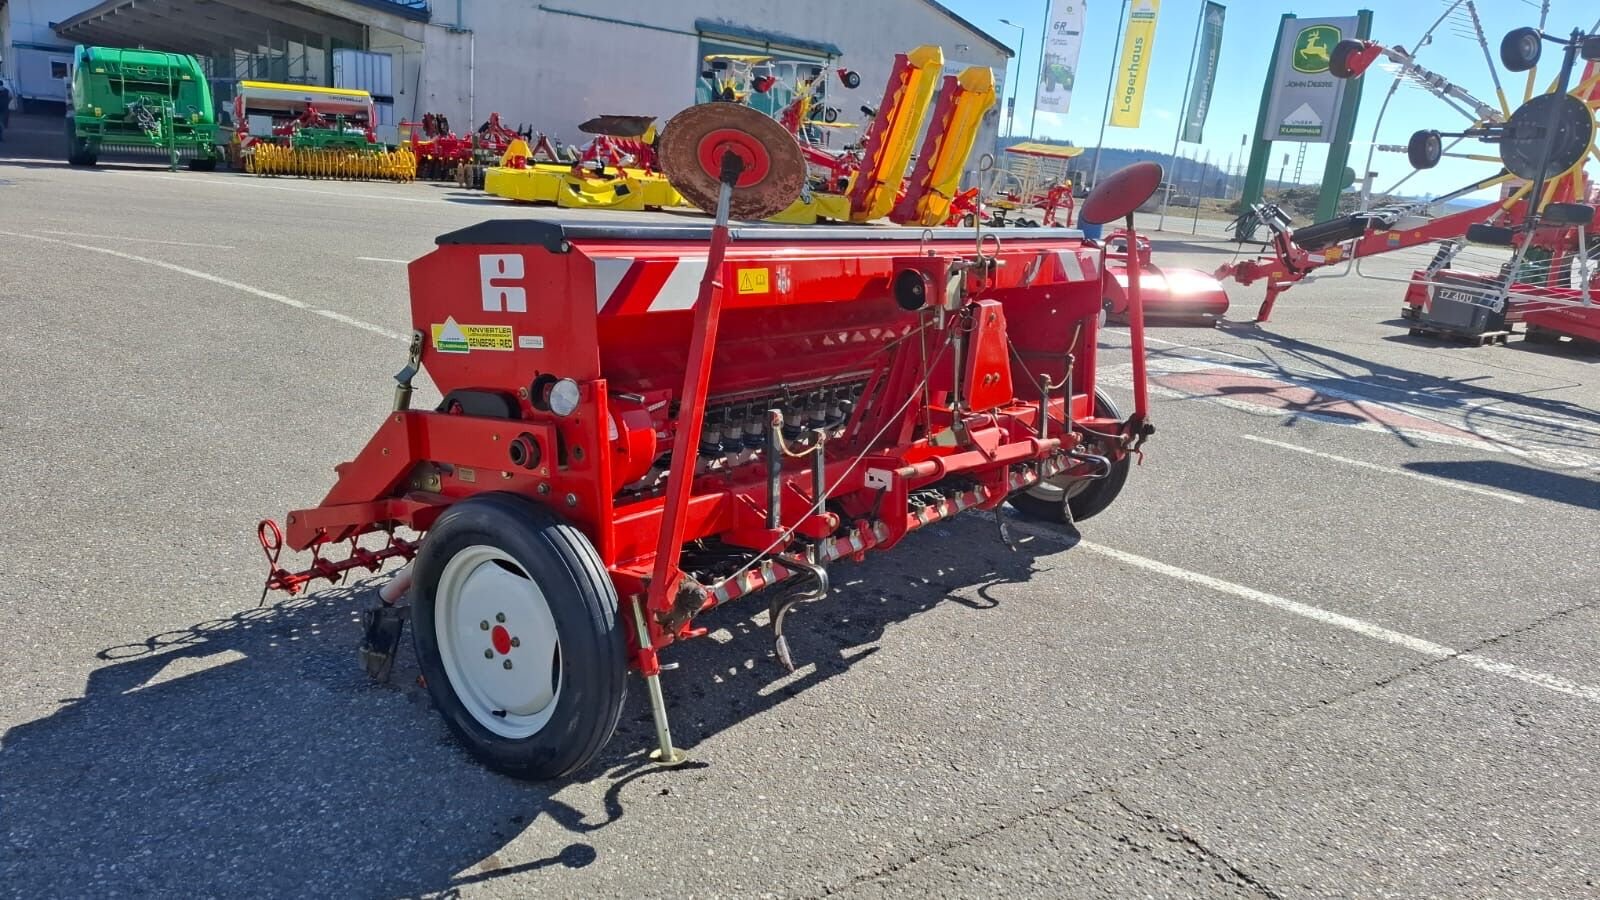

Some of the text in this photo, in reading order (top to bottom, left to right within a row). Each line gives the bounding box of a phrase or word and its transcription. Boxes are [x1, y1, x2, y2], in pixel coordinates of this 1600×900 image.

[1053, 21, 1067, 31] 6R
[1120, 37, 1144, 113] Lagerhaus
[1285, 80, 1307, 88] JOHN
